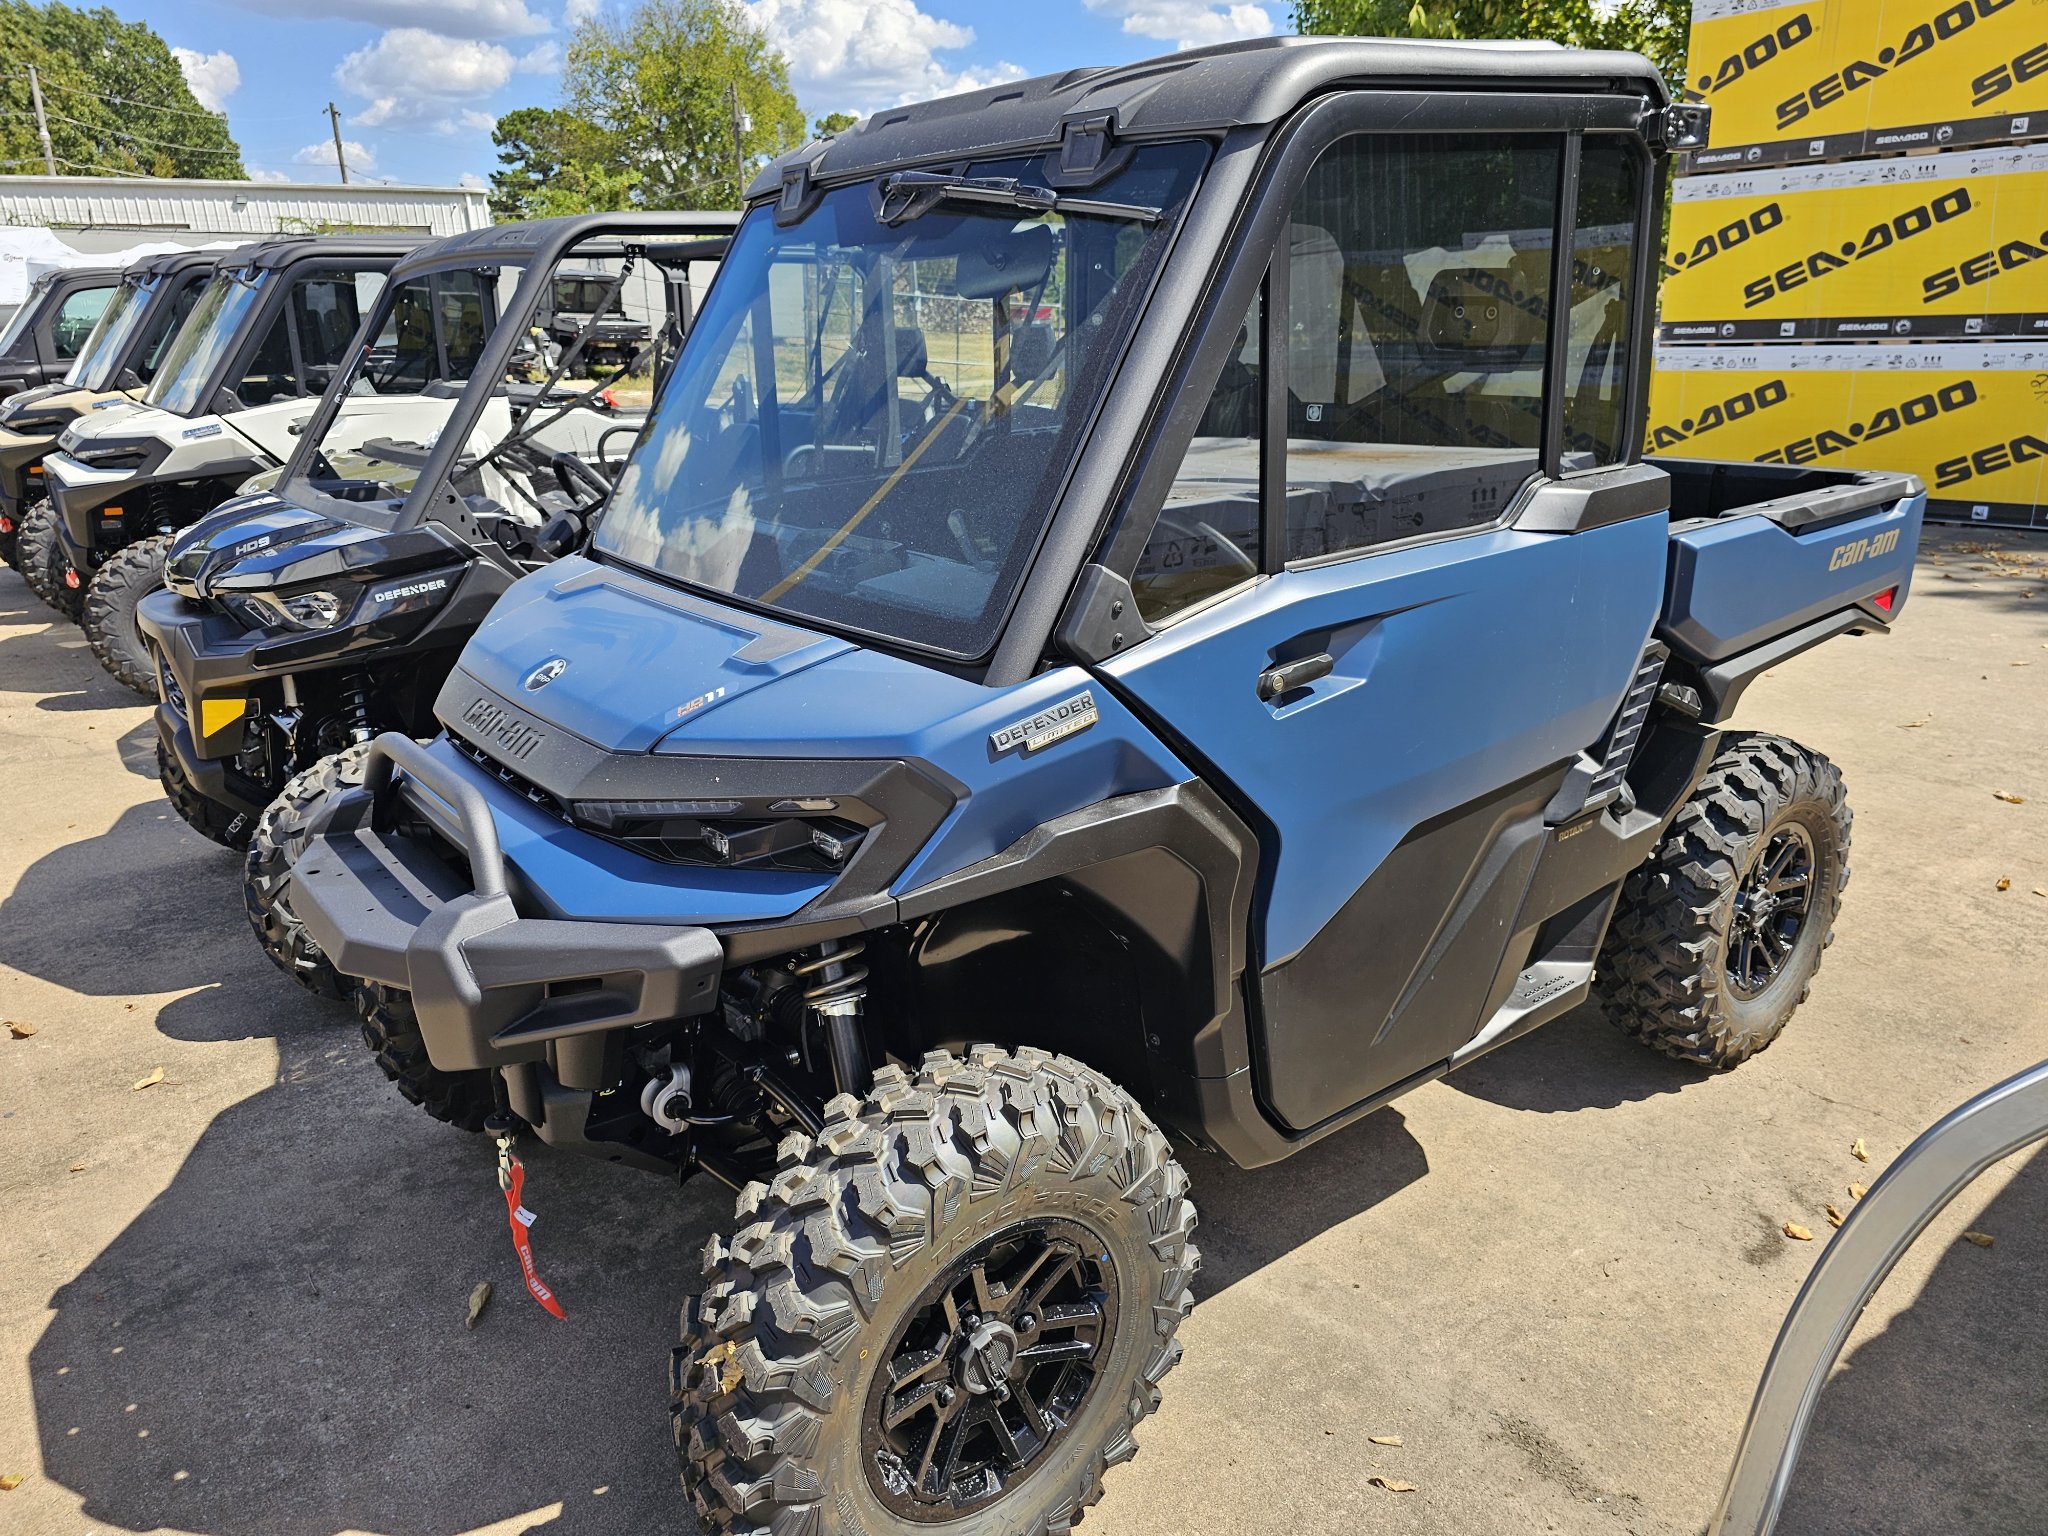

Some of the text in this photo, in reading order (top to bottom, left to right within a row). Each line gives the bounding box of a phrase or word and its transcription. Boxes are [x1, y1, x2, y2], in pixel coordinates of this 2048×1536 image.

[235, 535, 270, 556] HD9
[1828, 528, 1900, 571] can-am
[374, 579, 446, 603] DEFENDER
[677, 686, 725, 714] HD11
[461, 697, 547, 761] can-am
[997, 696, 1093, 746] DEFENDER
[1030, 712, 1095, 746] LIMITED
[520, 1245, 552, 1301] can-am
